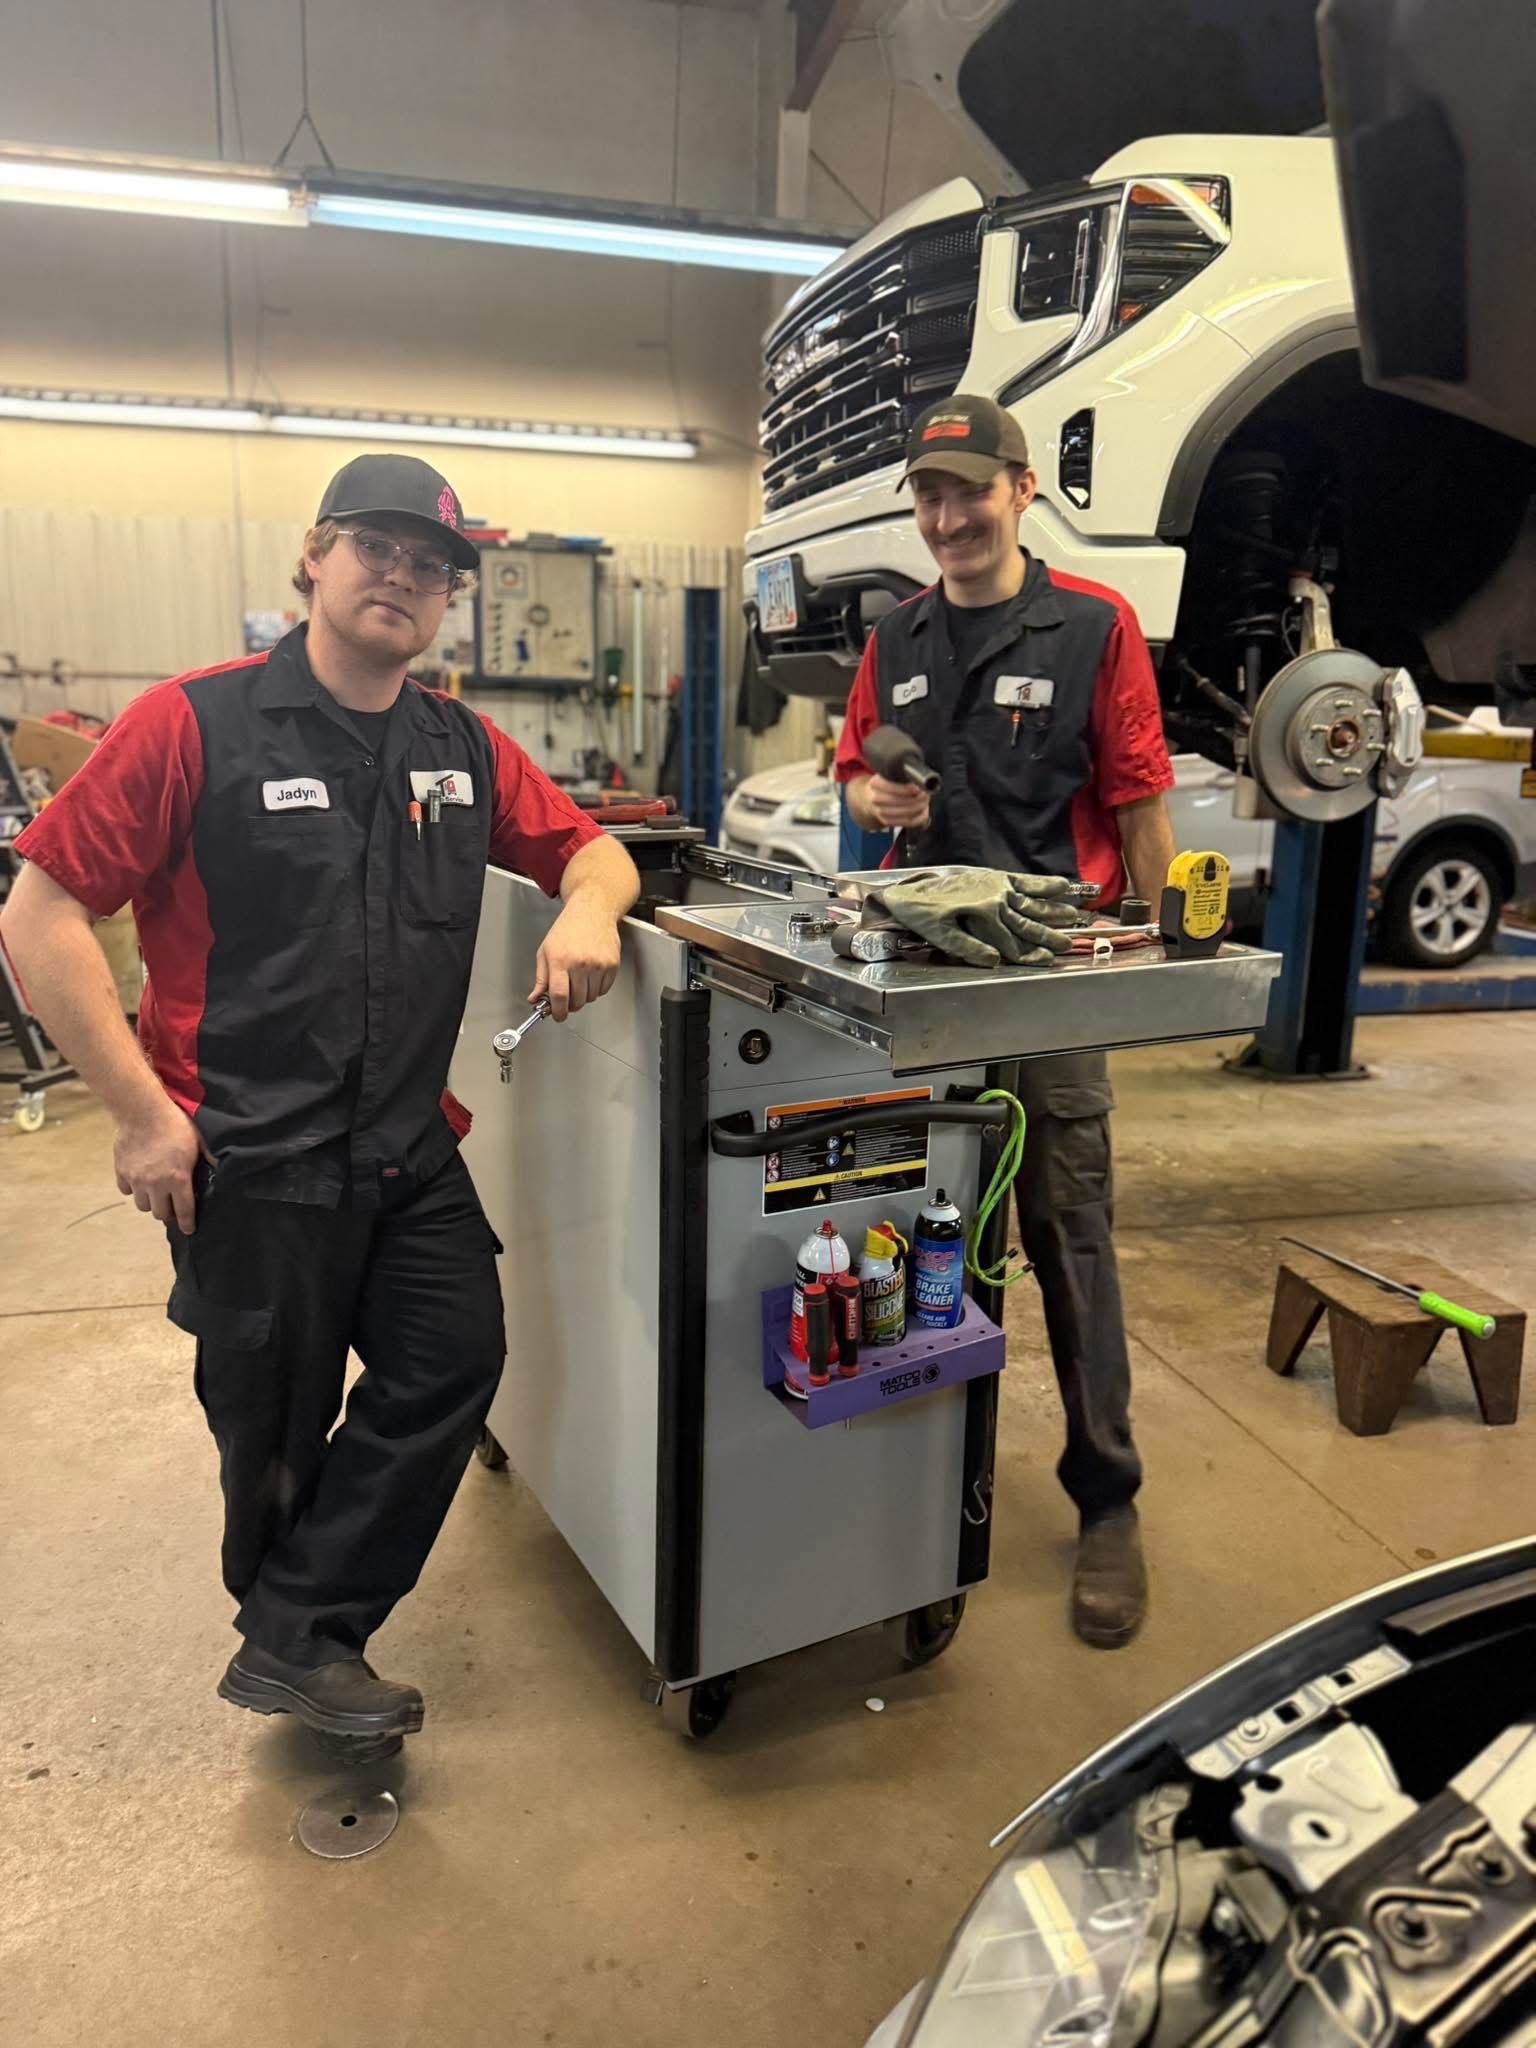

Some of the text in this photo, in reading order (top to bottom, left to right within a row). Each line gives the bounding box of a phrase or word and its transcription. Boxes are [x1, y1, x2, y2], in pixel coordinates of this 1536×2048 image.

[277, 787, 317, 801] Jadyn
[841, 1171, 863, 1179] CAUTION
[916, 1280, 951, 1295] BRAKE
[880, 1370, 920, 1390] MATCO
[880, 1378, 920, 1396] TOOLS
